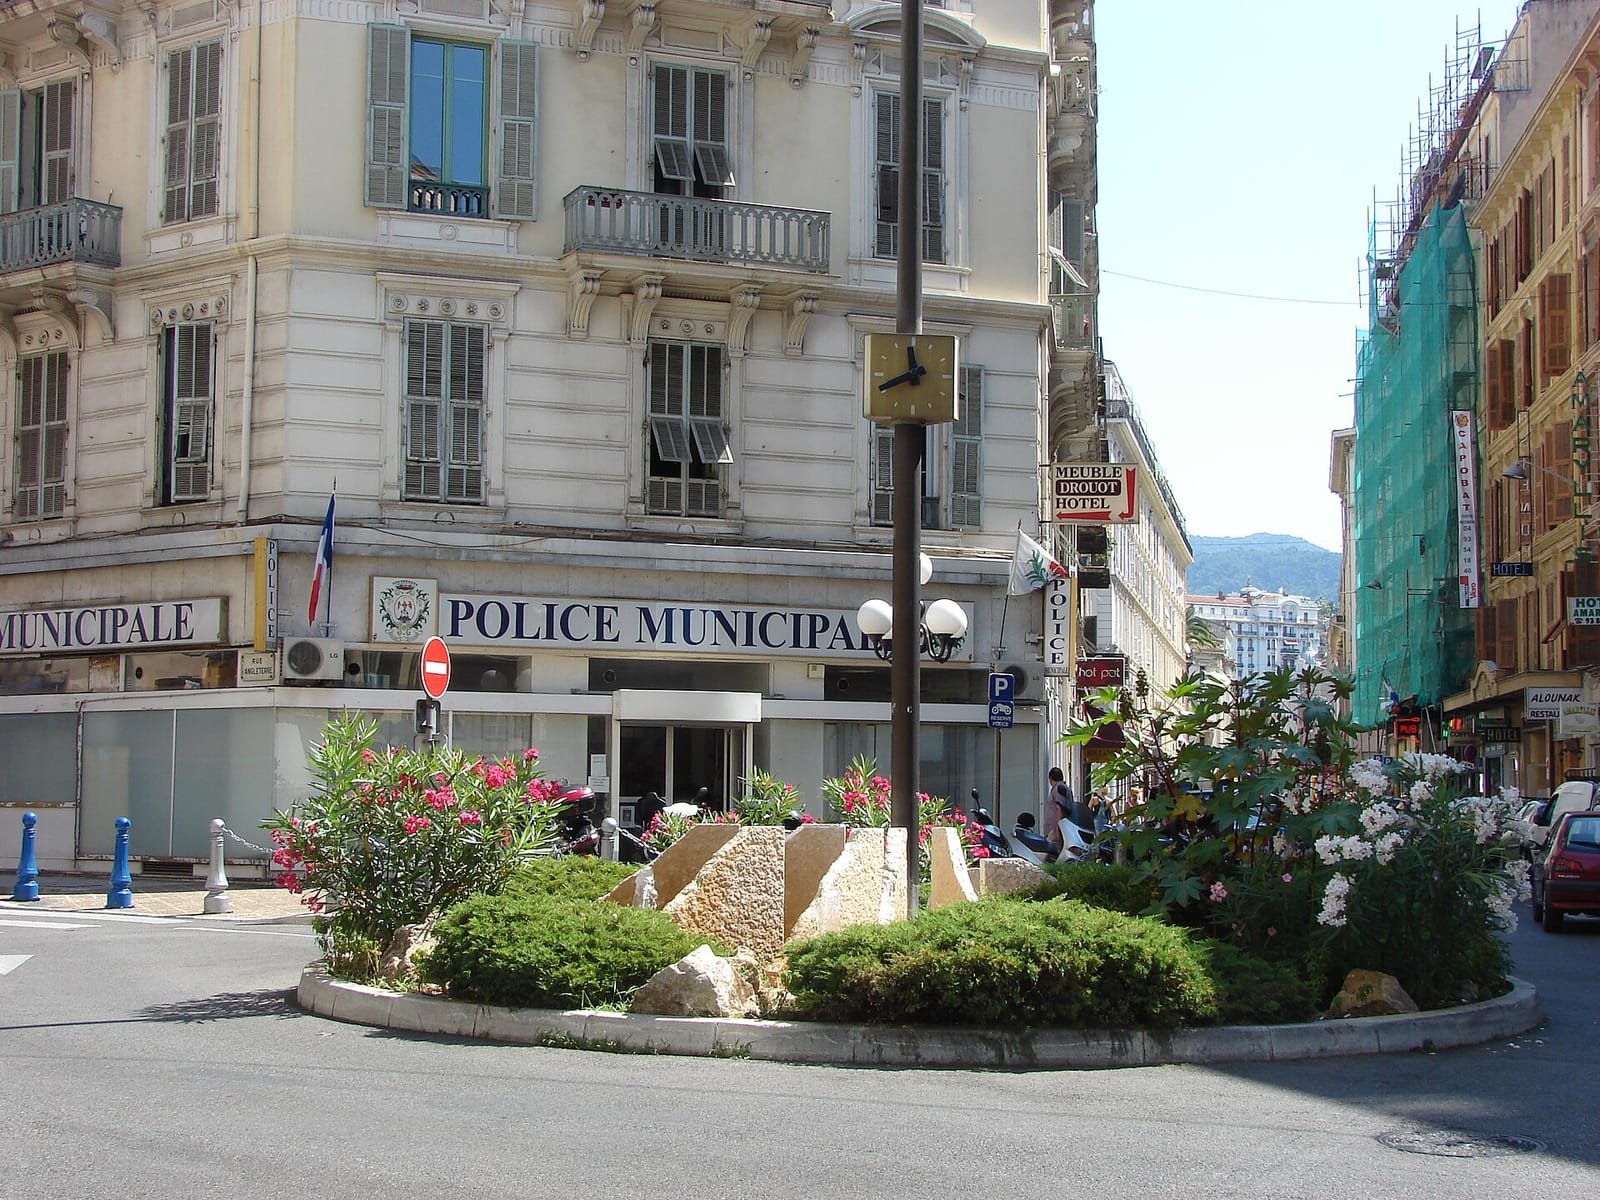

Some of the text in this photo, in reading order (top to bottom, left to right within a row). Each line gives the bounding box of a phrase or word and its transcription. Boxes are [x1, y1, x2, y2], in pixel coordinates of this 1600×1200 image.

[1055, 466, 1122, 479] MEUBLE
[1458, 430, 1470, 511] CAPOBAT
[1060, 482, 1117, 494] DROUOT
[1055, 497, 1110, 509] HOTEL
[1493, 564, 1529, 576] HOTEL
[268, 541, 276, 638] POLICE
[0, 603, 194, 649] MUNICIPALE
[447, 599, 893, 652] POLICE MUNICIPA
[1050, 580, 1067, 664] POLICE
[1078, 666, 1097, 677] hot
[1101, 667, 1121, 681] pot
[995, 678, 1008, 696] P
[1531, 693, 1581, 703] ALOUNAK
[1400, 725, 1417, 734] PUB
[1487, 728, 1520, 741] HOTEL
